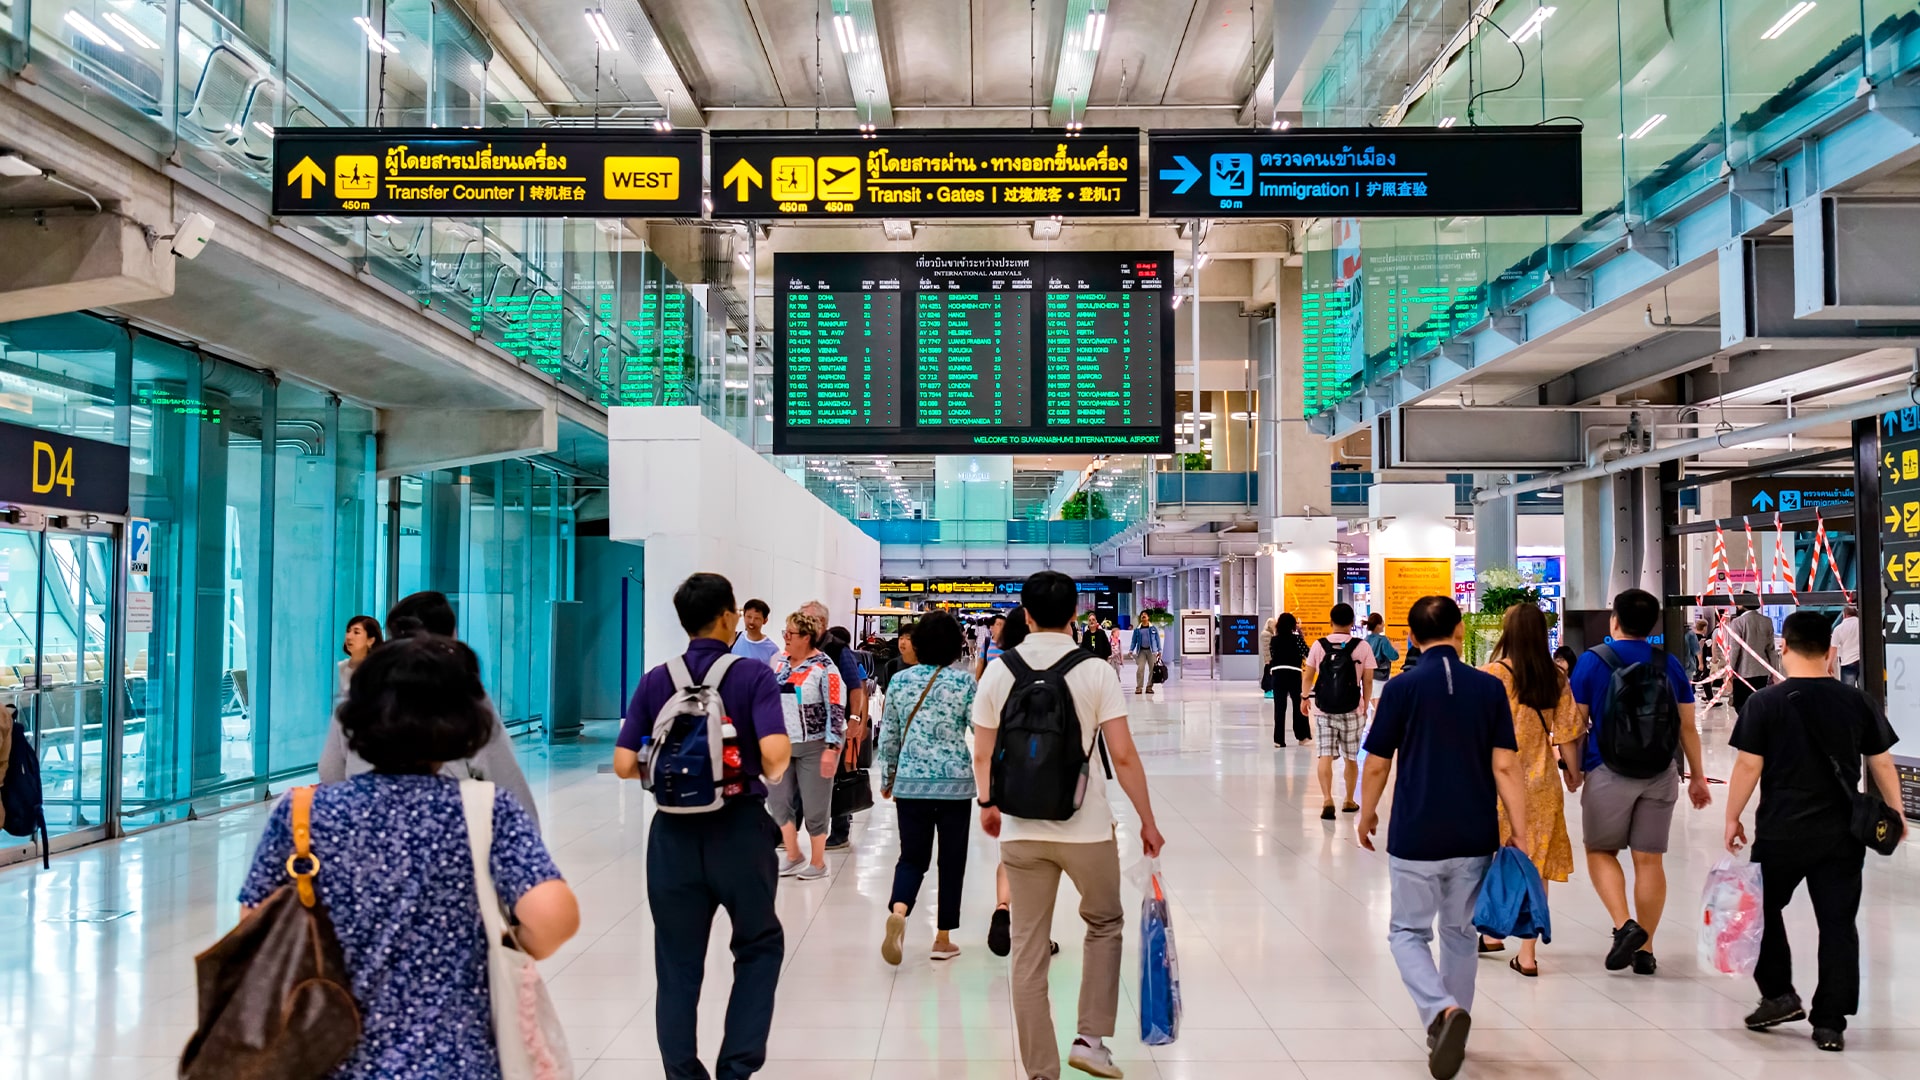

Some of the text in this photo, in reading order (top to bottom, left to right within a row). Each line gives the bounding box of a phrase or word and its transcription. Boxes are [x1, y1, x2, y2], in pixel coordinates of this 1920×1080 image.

[385, 143, 567, 177] ผู้โดยสารเปลี่ยนเครื่อง
[866, 144, 1128, 178] ผู้โดยสารผ่าน ทางออกขึ้นเครื่อง
[1260, 146, 1396, 167] ตรวจคนเข้าเมือง
[612, 172, 673, 188] WEST
[385, 184, 515, 200] Transfer Counter
[529, 185, 587, 201] 转机柜台
[866, 185, 985, 203] Transit Gates
[1003, 186, 1063, 203] 过境旅客
[1079, 186, 1121, 203] 登机门
[1259, 181, 1350, 201] Immigration
[1366, 181, 1428, 198] 护照查验
[974, 436, 1160, 444] WELCOME TO SUVARNABHUMI INTERNATIONAL AIRPORT
[32, 441, 75, 497] D4
[1803, 488, 1854, 496] ตรวจคนเข้าเมือ
[136, 524, 150, 561] 2
[1894, 656, 1906, 690] 2
